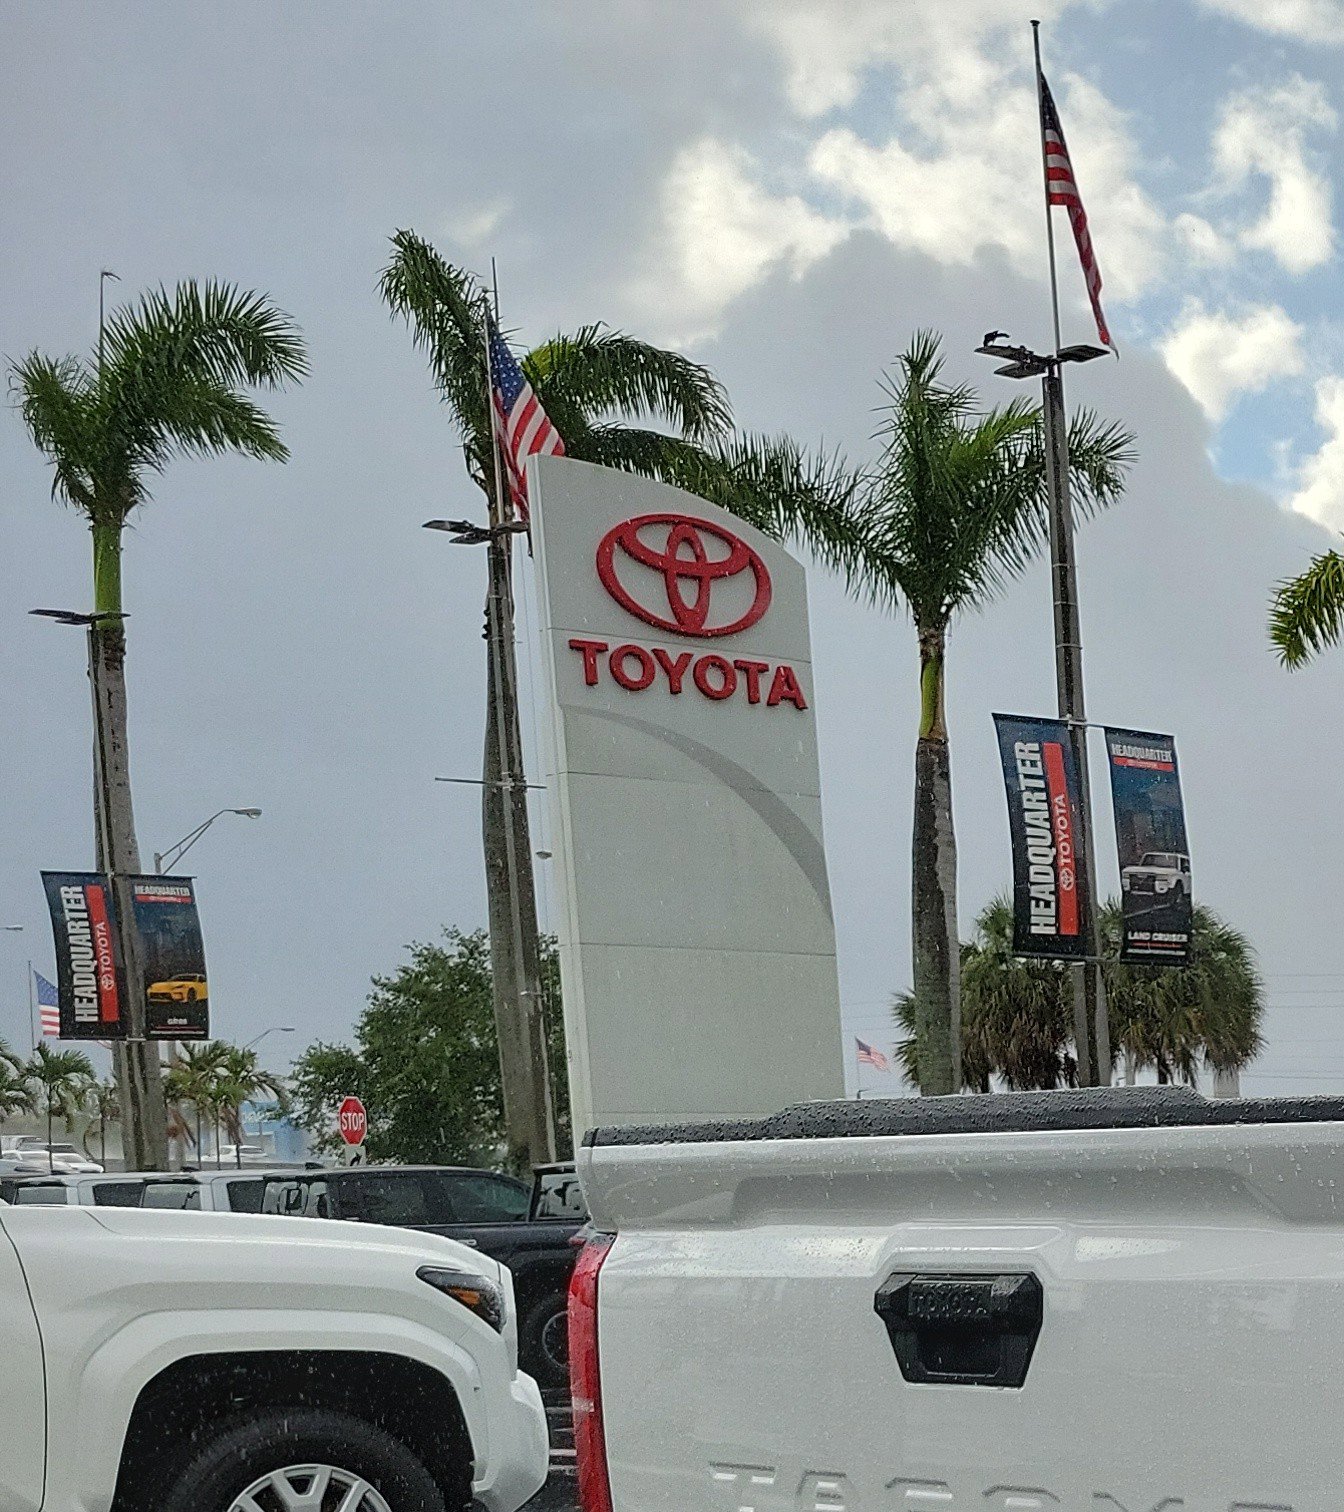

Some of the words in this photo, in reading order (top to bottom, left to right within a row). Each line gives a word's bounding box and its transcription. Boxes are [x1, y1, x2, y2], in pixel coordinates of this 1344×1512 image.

[568, 639, 808, 710] TOYOTA
[1014, 740, 1057, 935] HEADQUARTER
[1053, 794, 1072, 867] TOYOTA
[60, 885, 98, 1023] HEADQUARTER
[95, 921, 114, 973] TOYOTA
[341, 1112, 365, 1130] STOP
